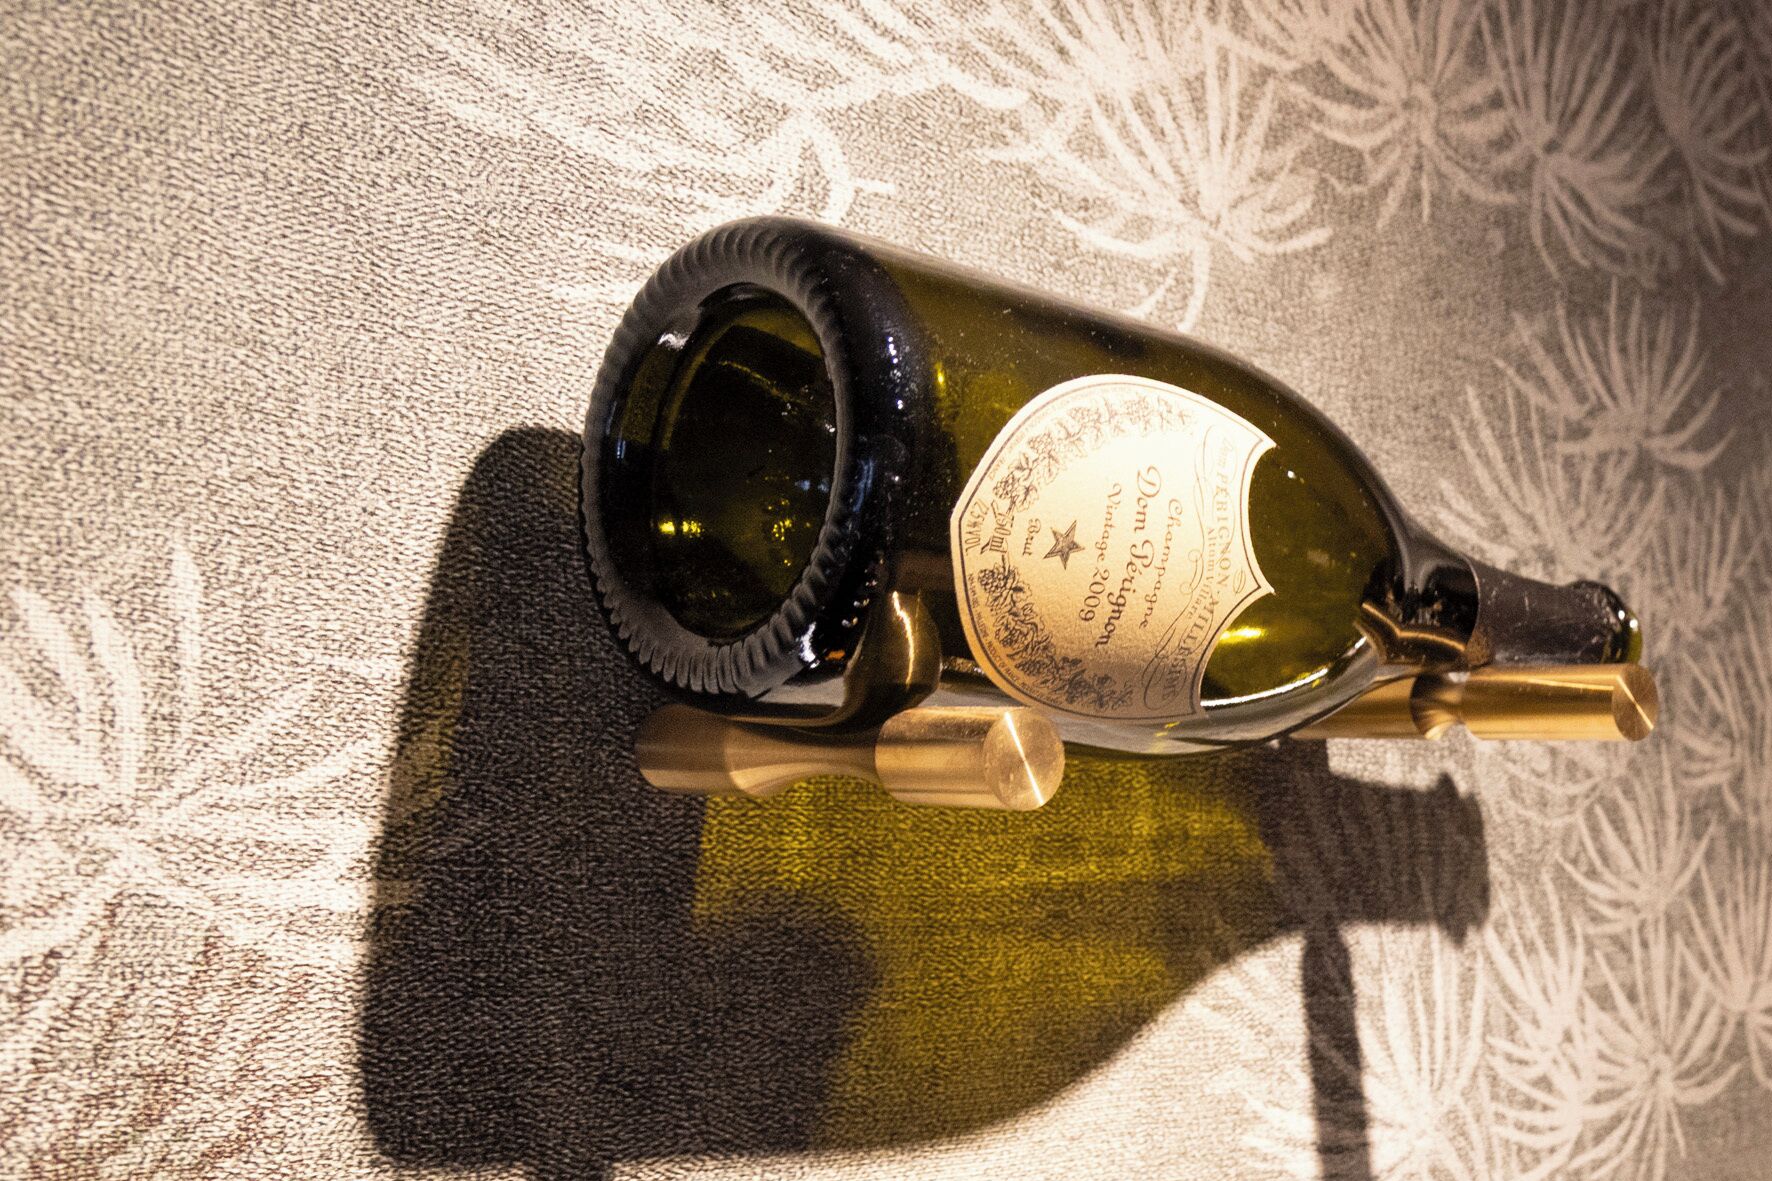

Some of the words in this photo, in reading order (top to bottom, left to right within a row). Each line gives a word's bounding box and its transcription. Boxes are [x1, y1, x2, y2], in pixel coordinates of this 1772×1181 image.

[1021, 517, 1043, 557] Brut
[1093, 482, 1122, 566] Vintage
[1133, 465, 1162, 534] Dom
[1079, 569, 1111, 623] 2009
[1094, 539, 1156, 649] Pérignon
[1137, 498, 1184, 631] Champagne
